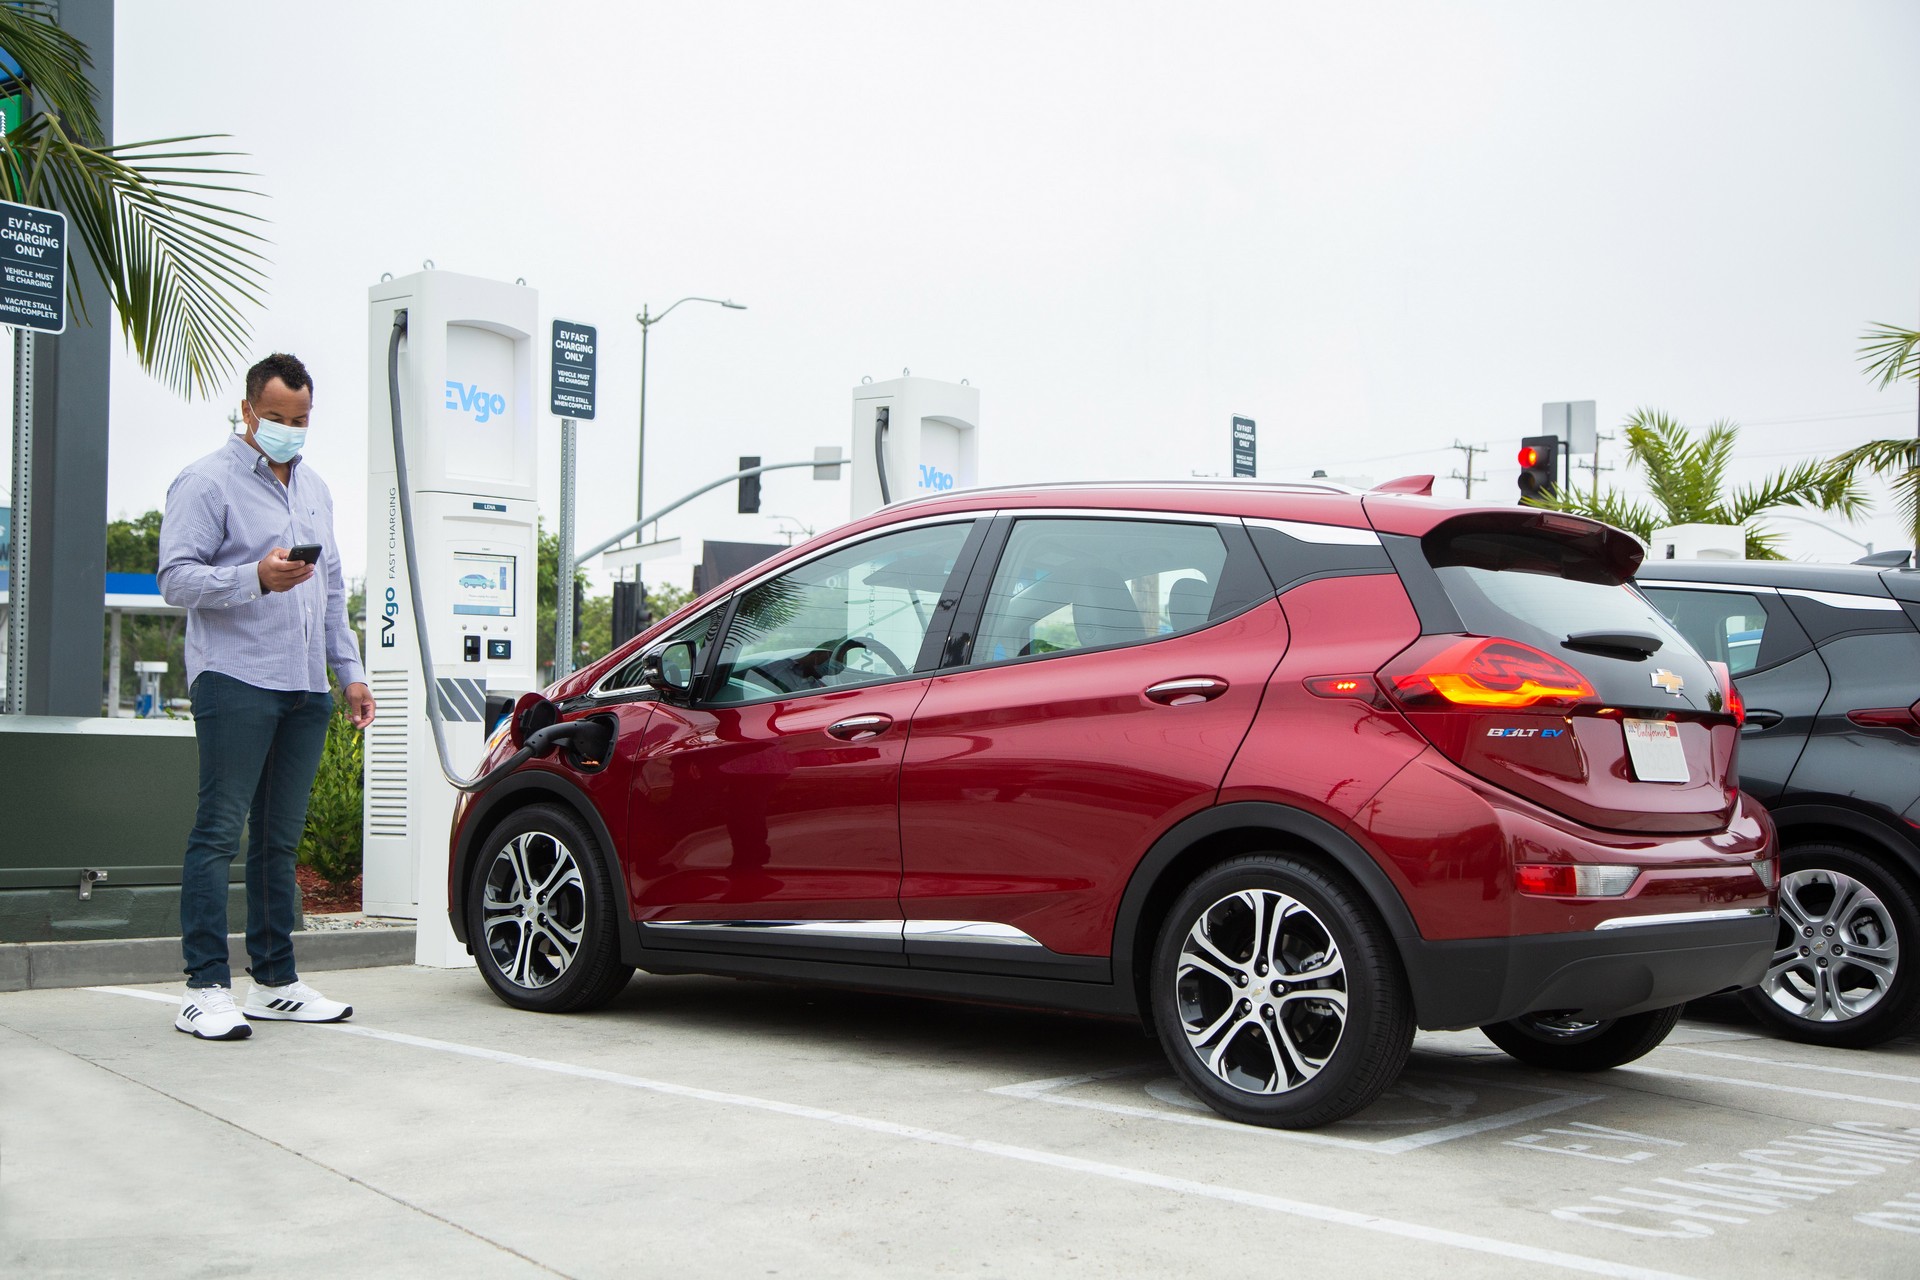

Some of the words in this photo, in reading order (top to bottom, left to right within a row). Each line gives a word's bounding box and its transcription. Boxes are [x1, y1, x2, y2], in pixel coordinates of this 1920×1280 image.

[8, 217, 23, 229] EV
[24, 220, 52, 235] FAST
[0, 229, 59, 249] CHARGING
[15, 244, 44, 258] ONLY
[4, 266, 33, 278] VEHICLE
[35, 272, 54, 281] MUST
[6, 274, 15, 283] BE
[15, 276, 52, 289] CHARGING
[4, 296, 32, 307] VACATE
[32, 301, 53, 311] STALL
[0, 304, 20, 313] WHEN
[21, 307, 58, 320] COMPLETE
[560, 330, 570, 340] EV
[570, 332, 589, 343] FAST
[555, 340, 593, 354] CHARGING
[564, 351, 584, 362] ONLY
[557, 370, 576, 379] VEHICLE
[577, 373, 590, 381] MUST
[565, 377, 589, 387] CHARGING
[446, 380, 505, 423] EVgo
[554, 399, 568, 408] WHEN
[568, 402, 592, 411] COMPLETE
[557, 394, 576, 402] VACATE
[575, 396, 589, 404] STALL
[389, 487, 397, 549] CHARGING
[388, 552, 396, 580] FAST
[382, 587, 398, 648] EVgo
[1487, 728, 1539, 738] BOLT
[1541, 729, 1564, 738] EV
[1501, 1122, 1687, 1164] EV
